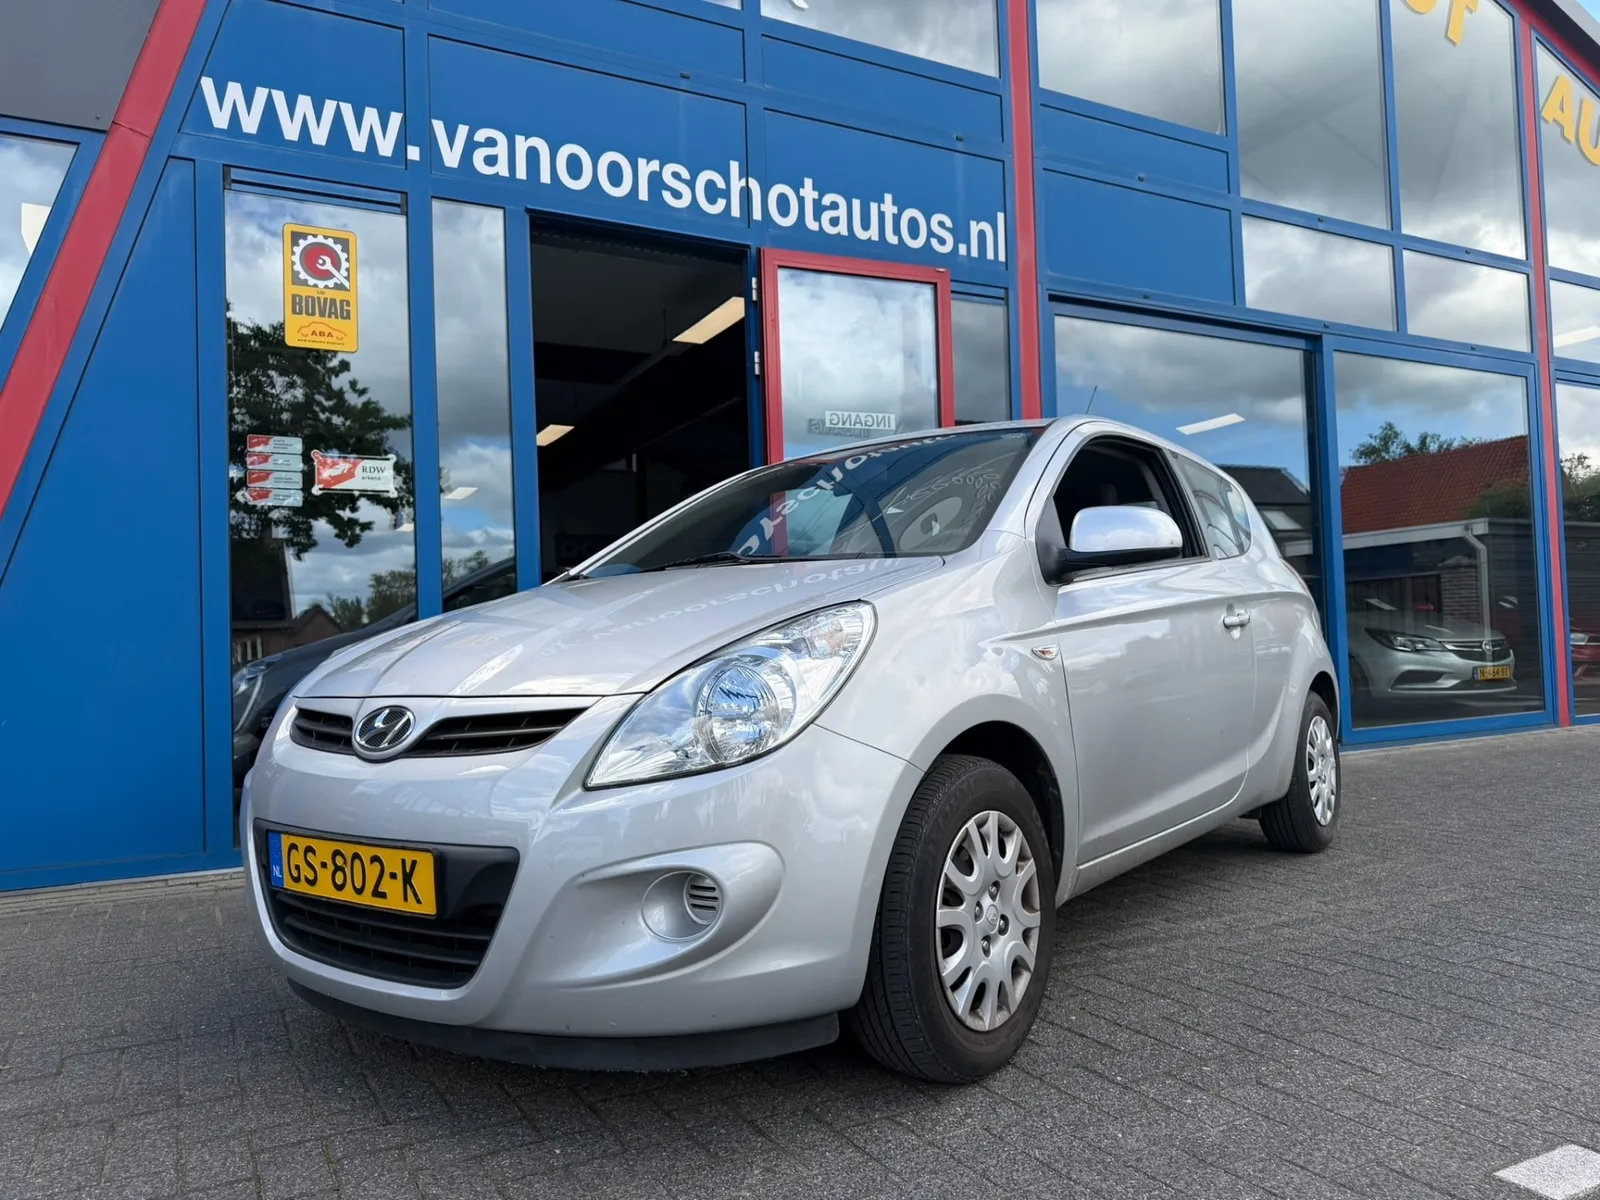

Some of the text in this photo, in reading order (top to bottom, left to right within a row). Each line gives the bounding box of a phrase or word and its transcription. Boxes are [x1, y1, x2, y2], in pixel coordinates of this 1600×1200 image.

[200, 76, 1006, 262] www.vanoorschotautos.nl
[291, 293, 351, 321] BOVAG
[310, 330, 334, 338] ABA
[361, 465, 386, 474] RDW
[272, 865, 282, 878] NL
[286, 842, 423, 905] GS-802-K
